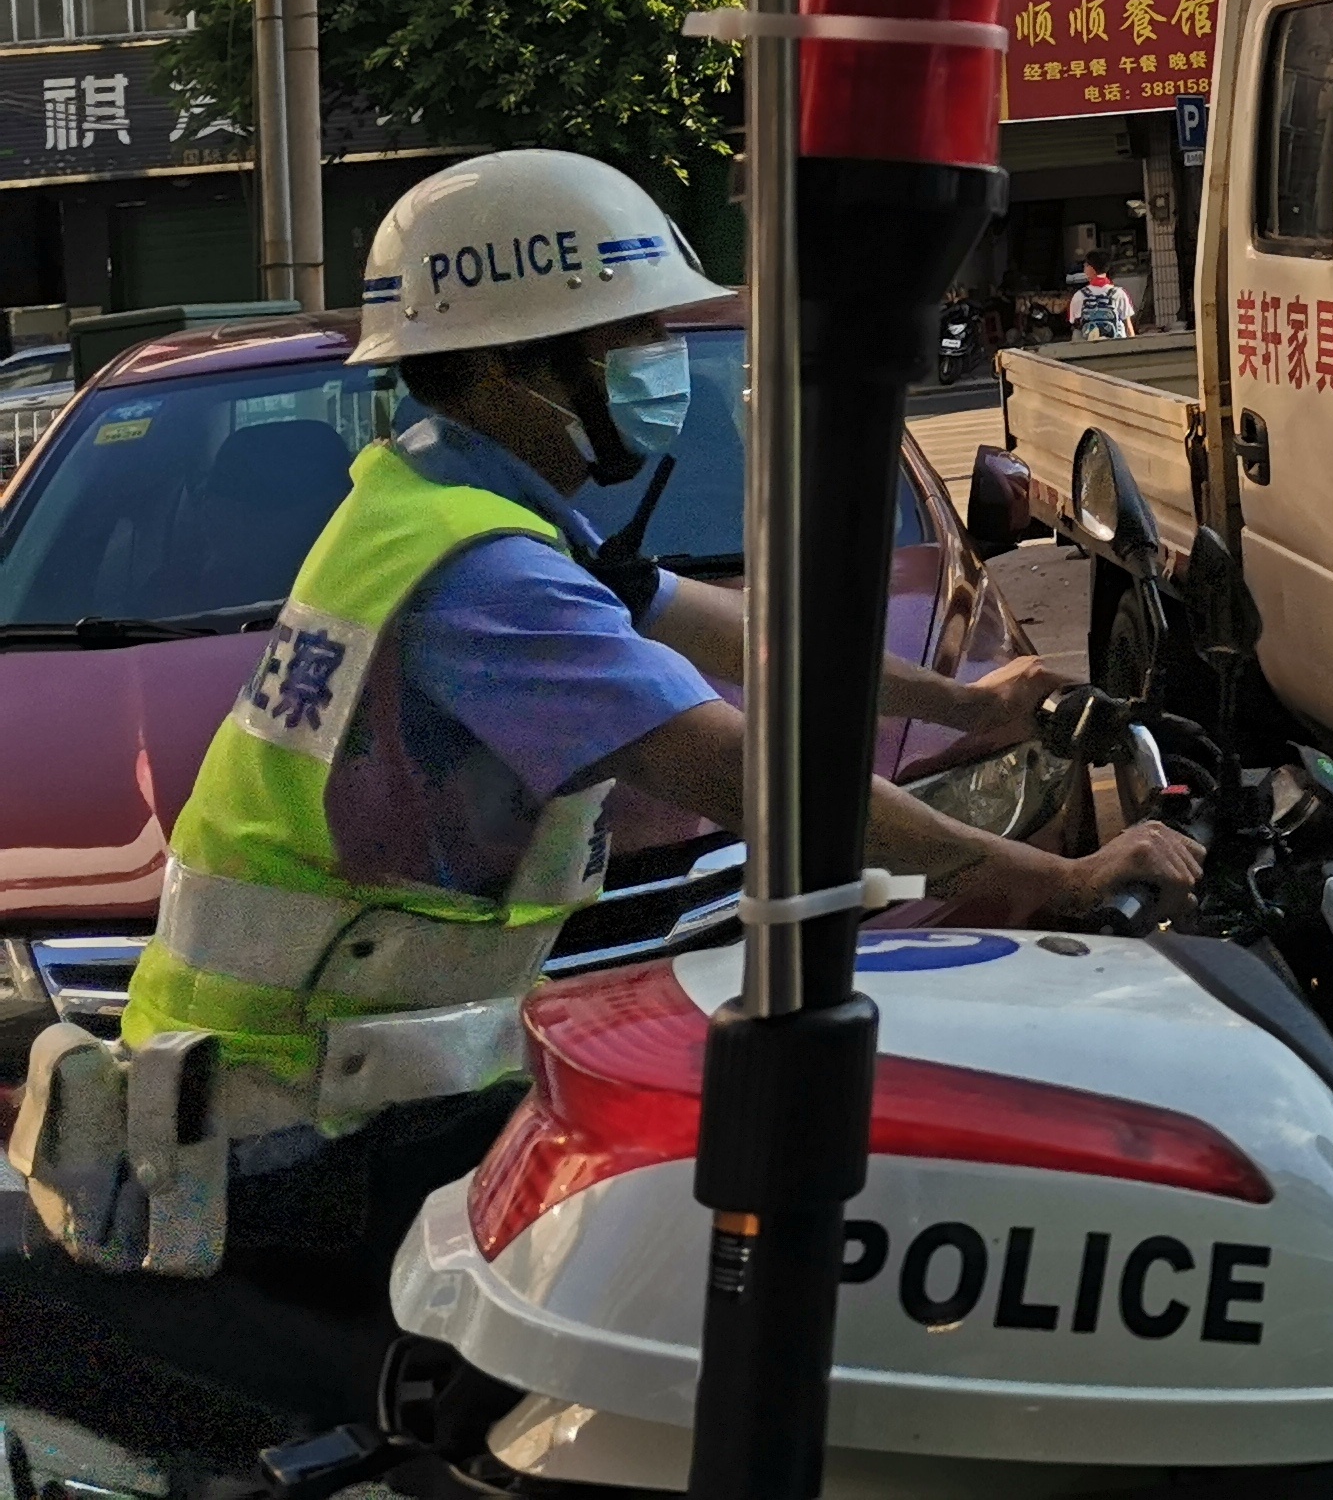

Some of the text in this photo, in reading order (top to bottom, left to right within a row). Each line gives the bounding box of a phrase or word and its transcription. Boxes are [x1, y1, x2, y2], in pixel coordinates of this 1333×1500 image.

[1119, 54, 1158, 75] 午餐
[1168, 50, 1208, 71] 晚餐
[1140, 78, 1211, 98] 388158
[1183, 104, 1200, 141] P
[429, 230, 583, 295] POLICE
[838, 1218, 1272, 1345] POLICE
